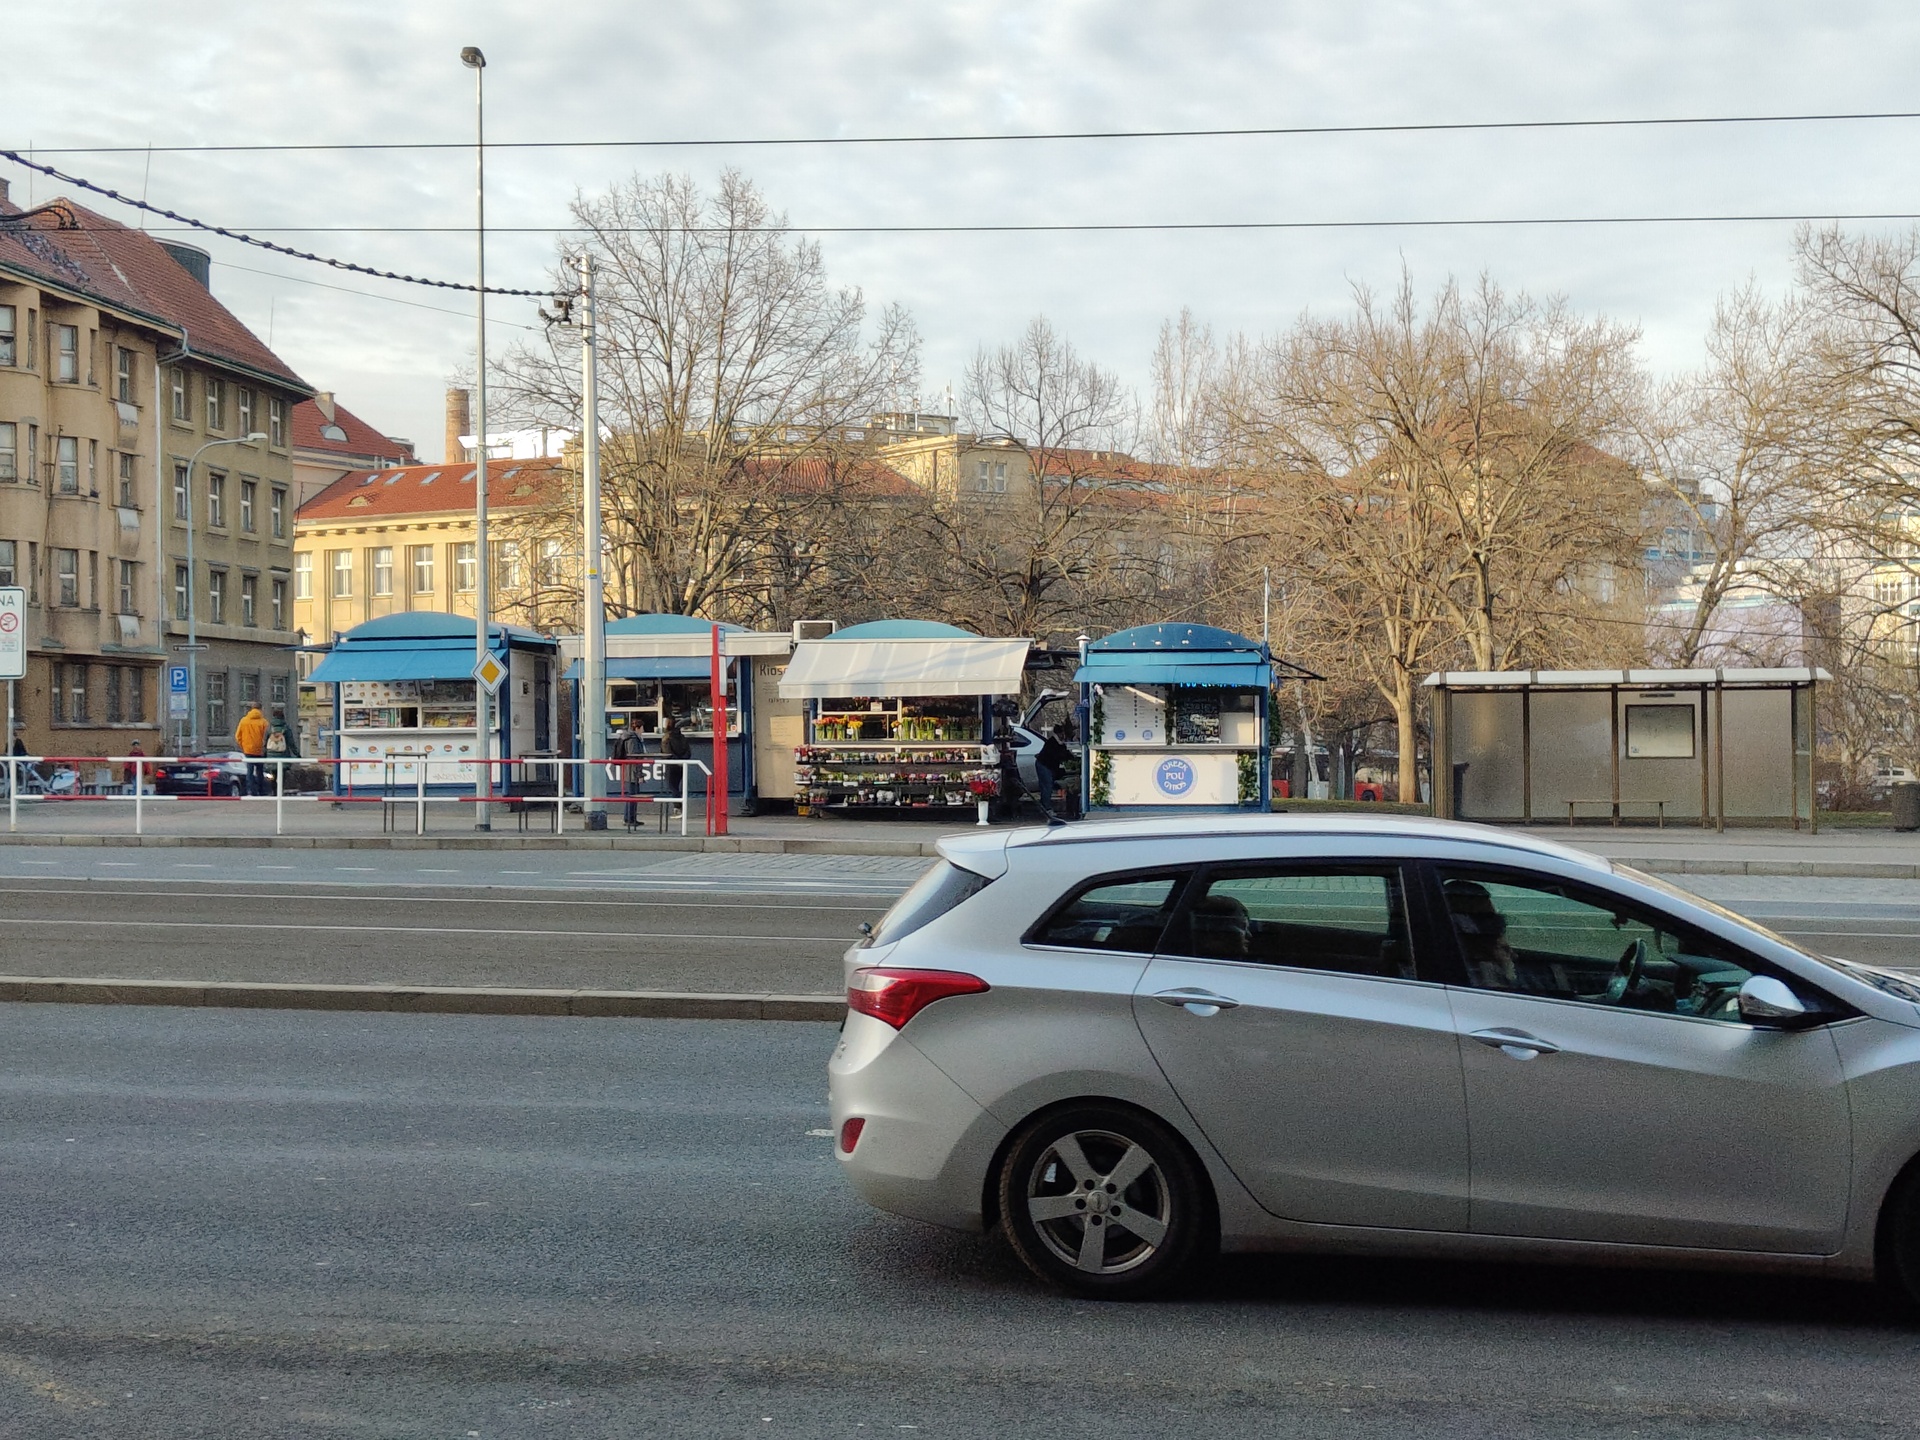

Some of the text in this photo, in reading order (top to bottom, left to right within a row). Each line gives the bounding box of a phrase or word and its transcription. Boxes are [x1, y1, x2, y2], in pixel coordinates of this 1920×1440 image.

[173, 670, 184, 686] P
[605, 756, 666, 781] Kise
[1162, 760, 1188, 772] GREEK
[1165, 772, 1185, 780] POU
